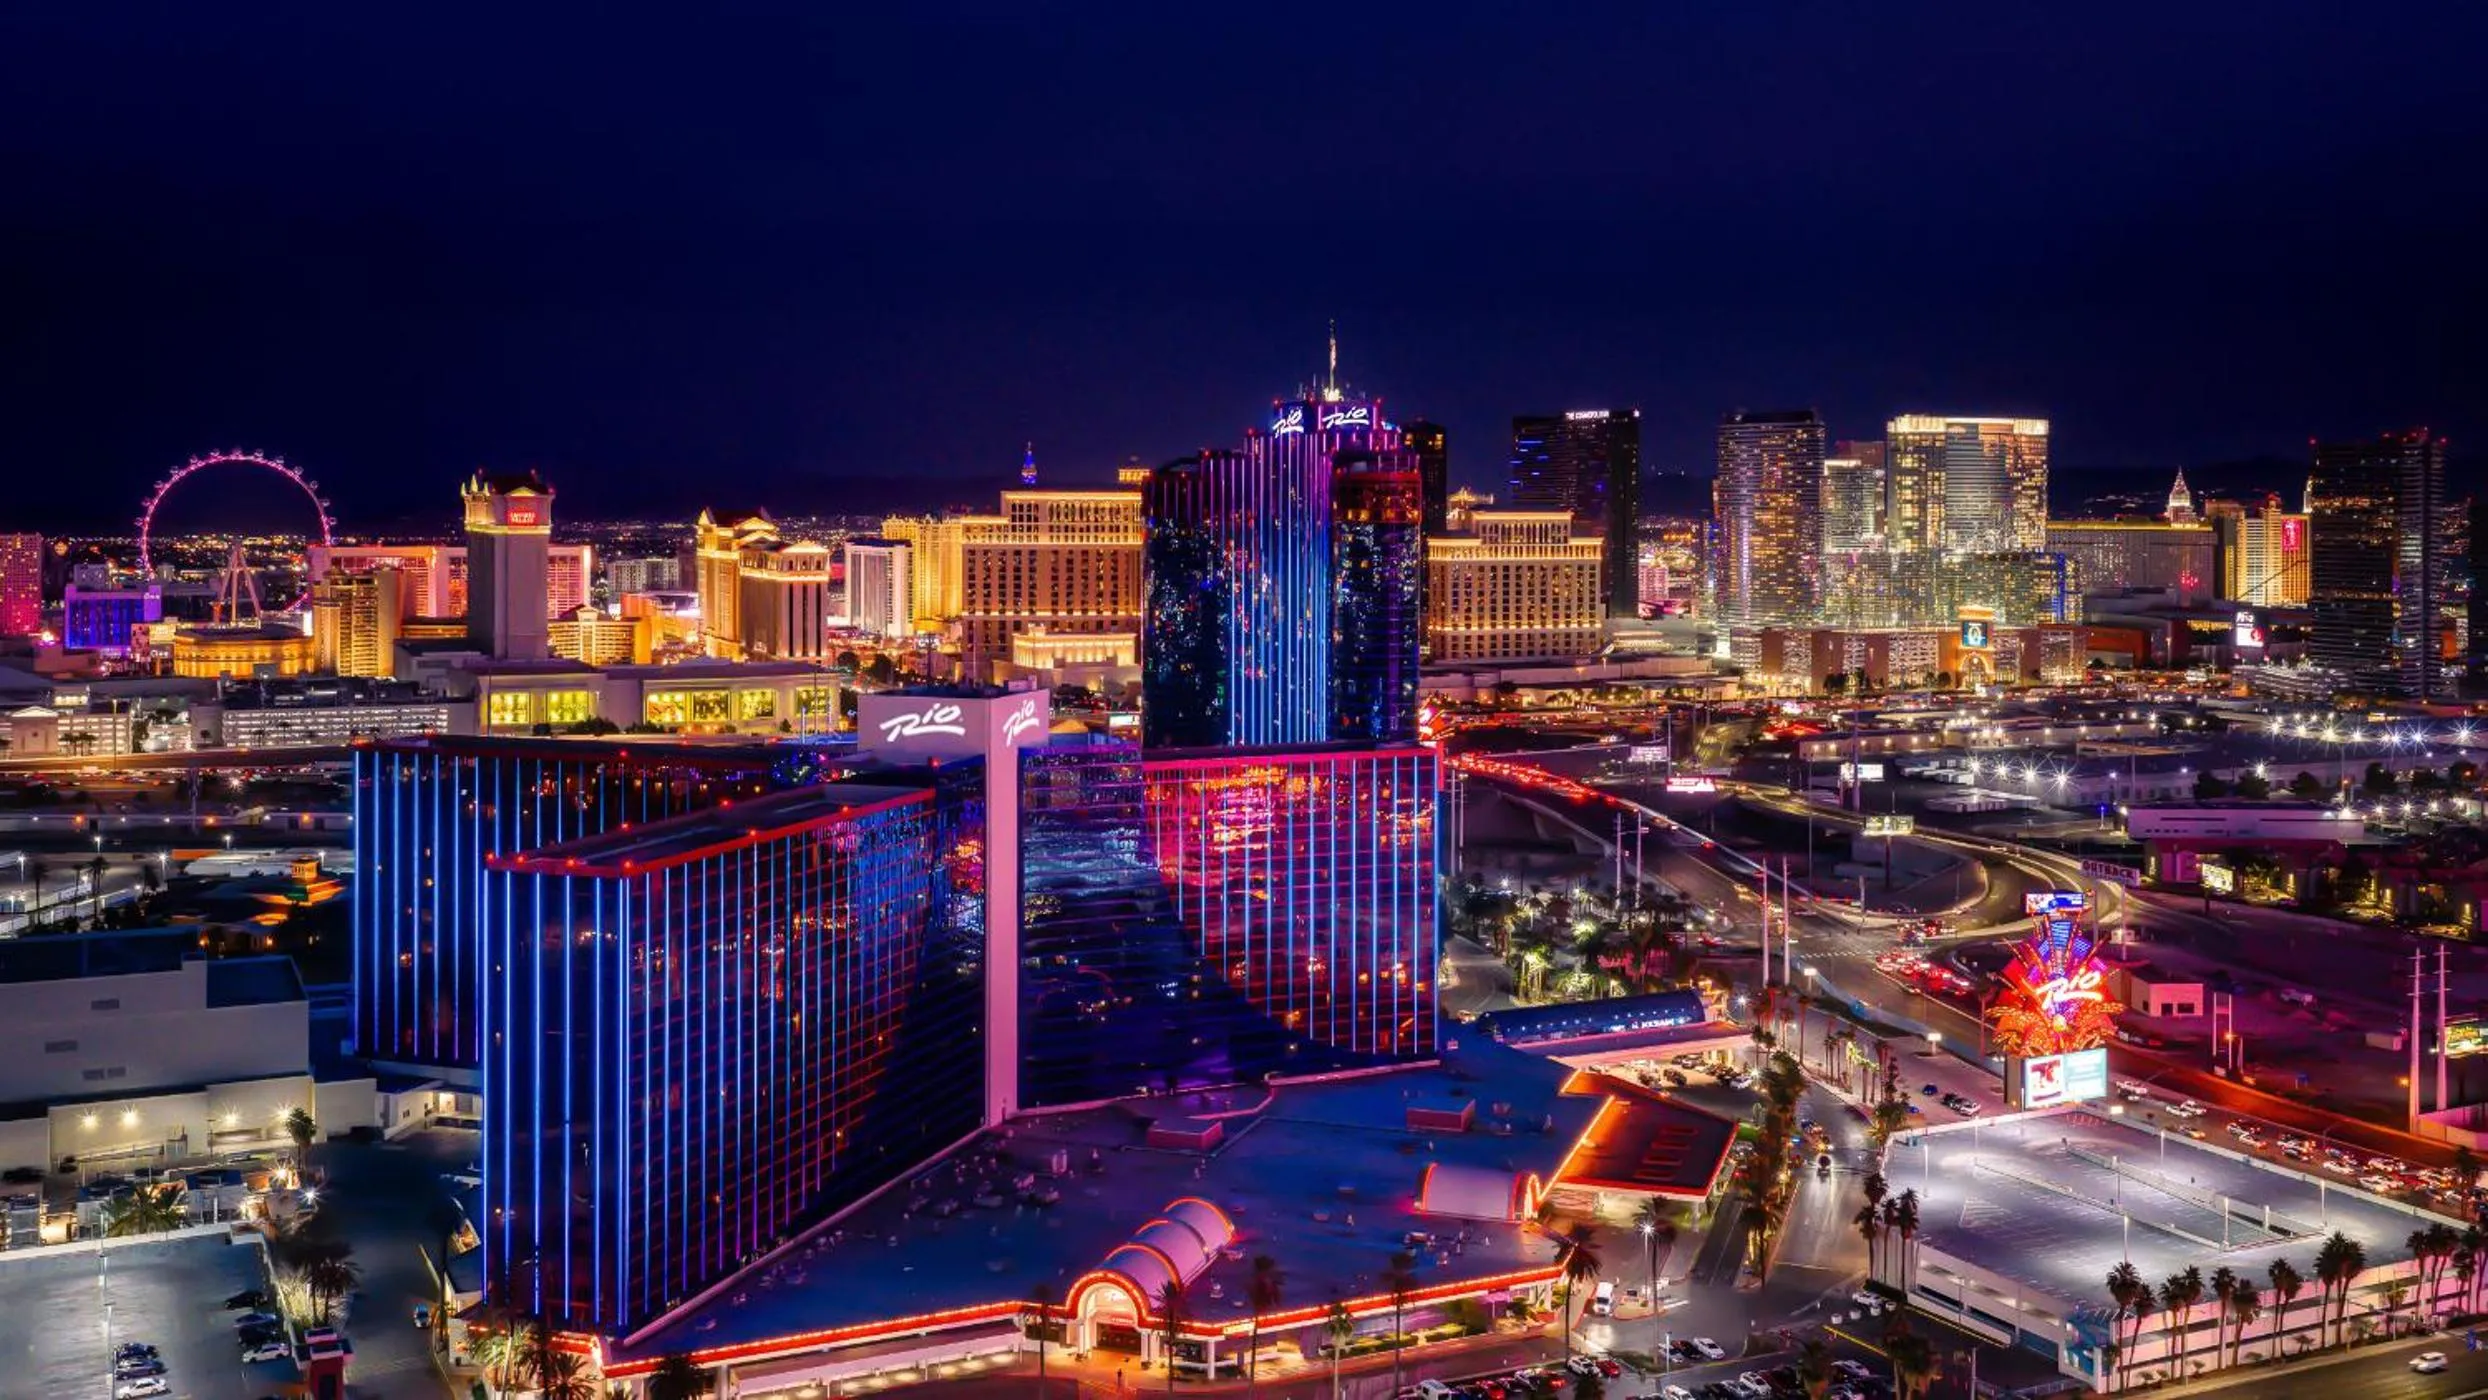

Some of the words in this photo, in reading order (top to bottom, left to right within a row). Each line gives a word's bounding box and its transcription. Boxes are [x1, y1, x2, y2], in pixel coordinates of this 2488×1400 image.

[1272, 406, 1304, 439] Rio
[1322, 406, 1370, 429] Rio
[879, 703, 966, 742] Rio
[1002, 699, 1040, 747] Rio
[2035, 967, 2103, 1010] Rio
